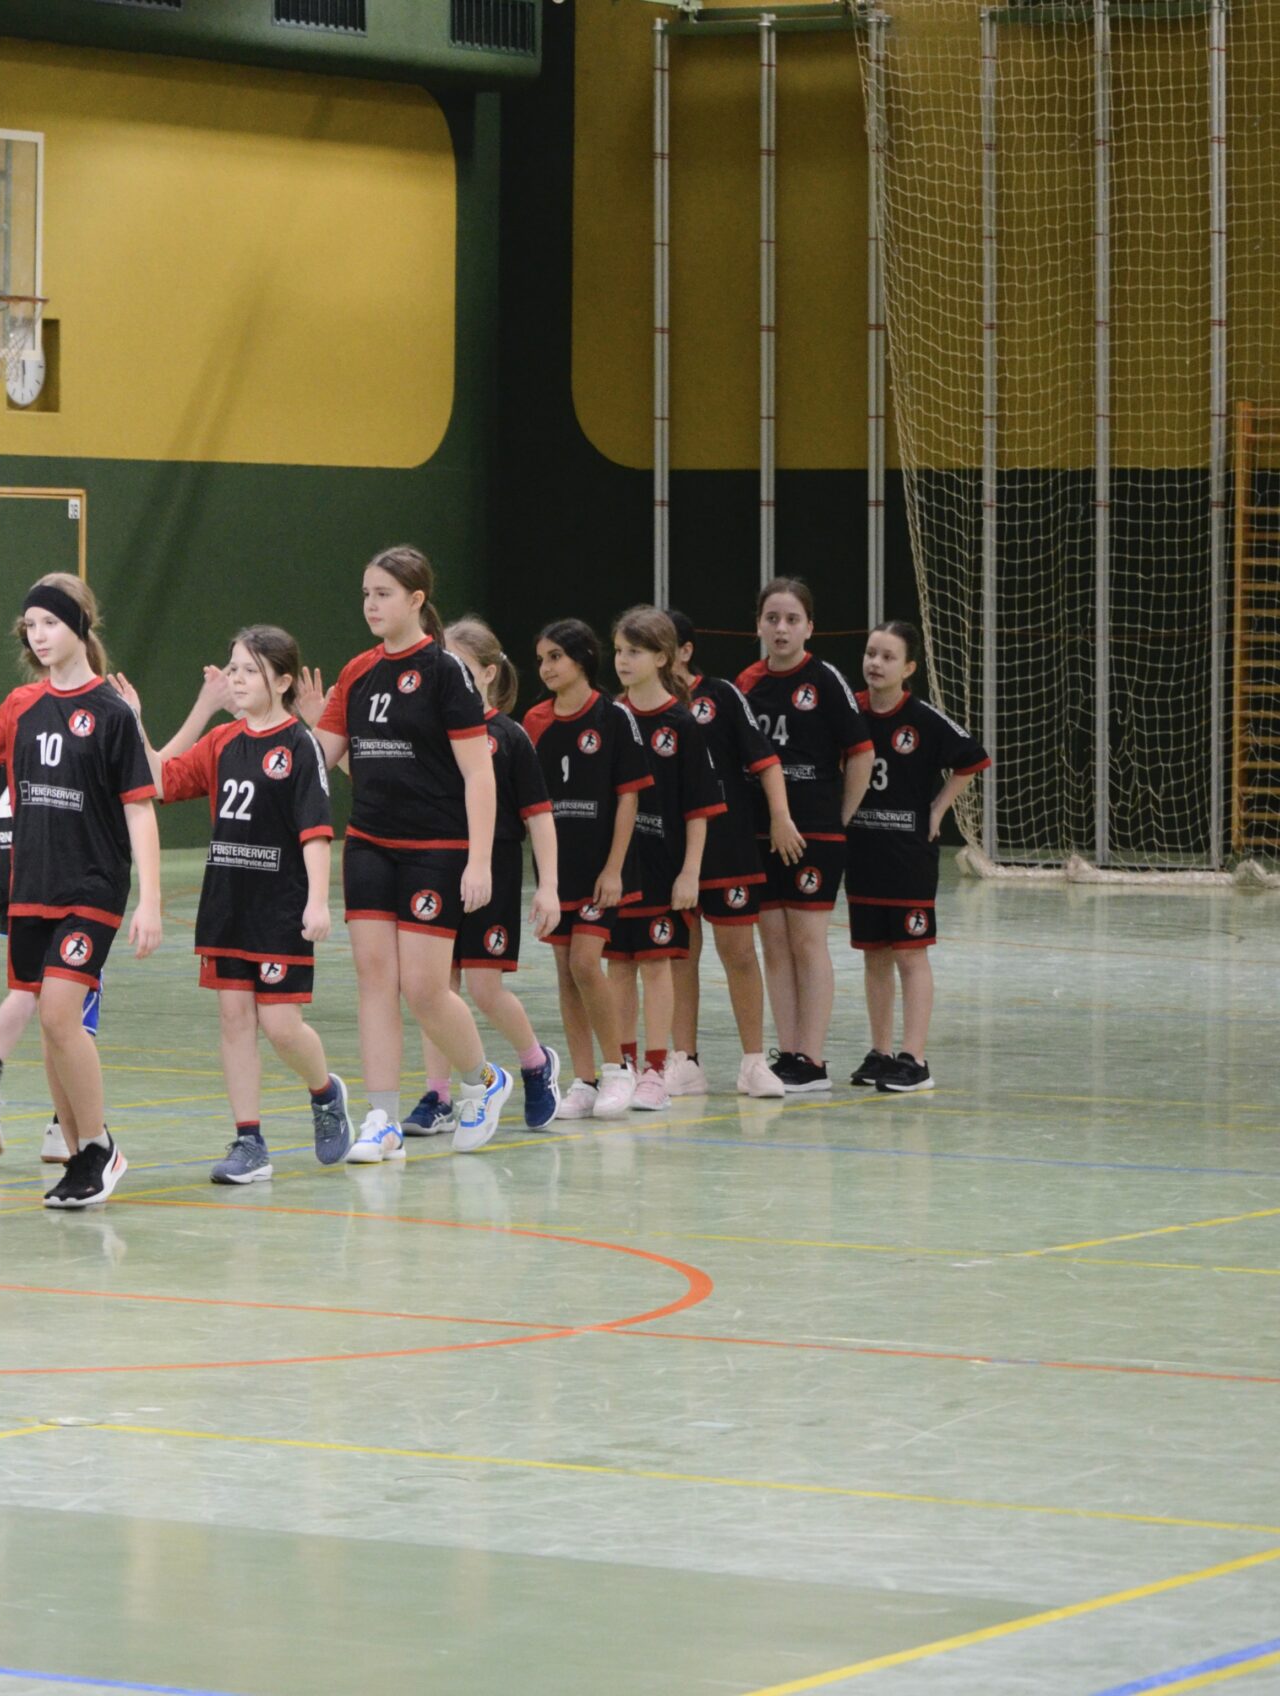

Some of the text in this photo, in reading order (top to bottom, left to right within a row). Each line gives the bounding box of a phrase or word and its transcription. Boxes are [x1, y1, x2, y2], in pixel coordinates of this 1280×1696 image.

[368, 692, 392, 723] 12
[757, 714, 790, 746] 24
[36, 732, 63, 767] 10
[867, 758, 888, 791] 3
[220, 779, 255, 820] 22
